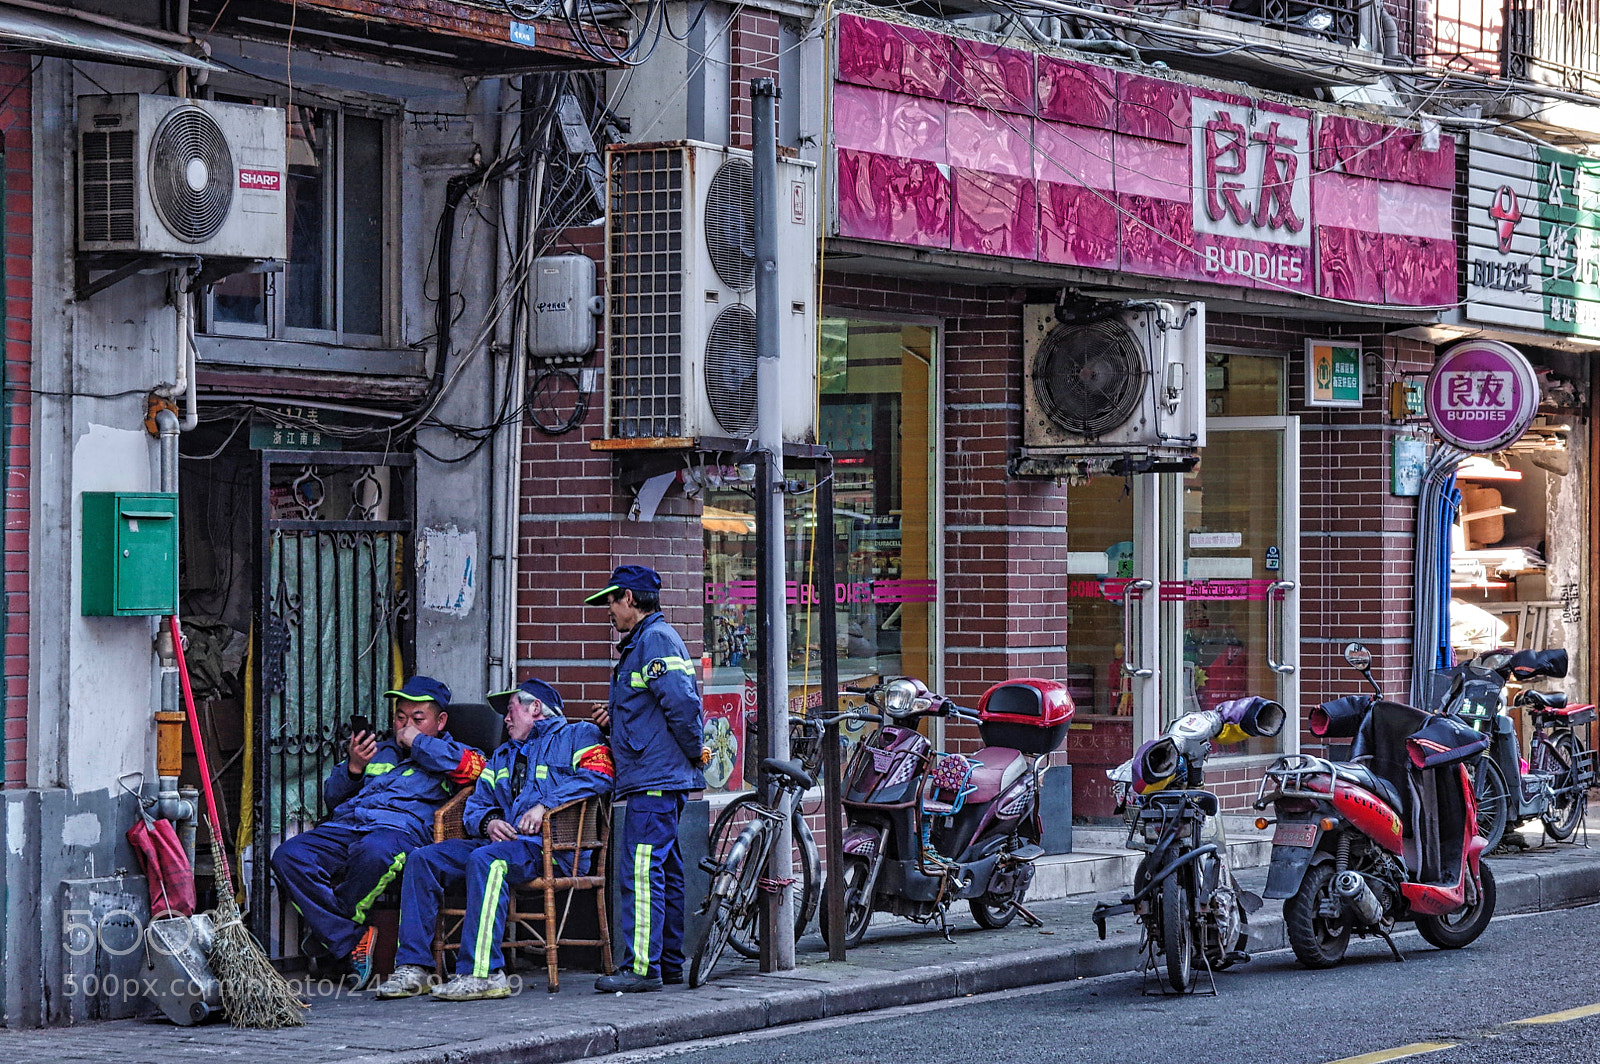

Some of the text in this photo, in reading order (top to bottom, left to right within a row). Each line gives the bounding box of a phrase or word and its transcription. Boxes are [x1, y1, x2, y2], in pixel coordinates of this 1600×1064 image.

[241, 172, 278, 185] SHARP
[1205, 110, 1304, 233] 良友
[1205, 245, 1302, 283] BUDDIES
[1447, 374, 1506, 407] 良友
[1447, 410, 1506, 421] BUDDIES
[272, 431, 321, 445] 浙江南路
[800, 582, 871, 604] BUDIES
[1067, 581, 1101, 597] COME
